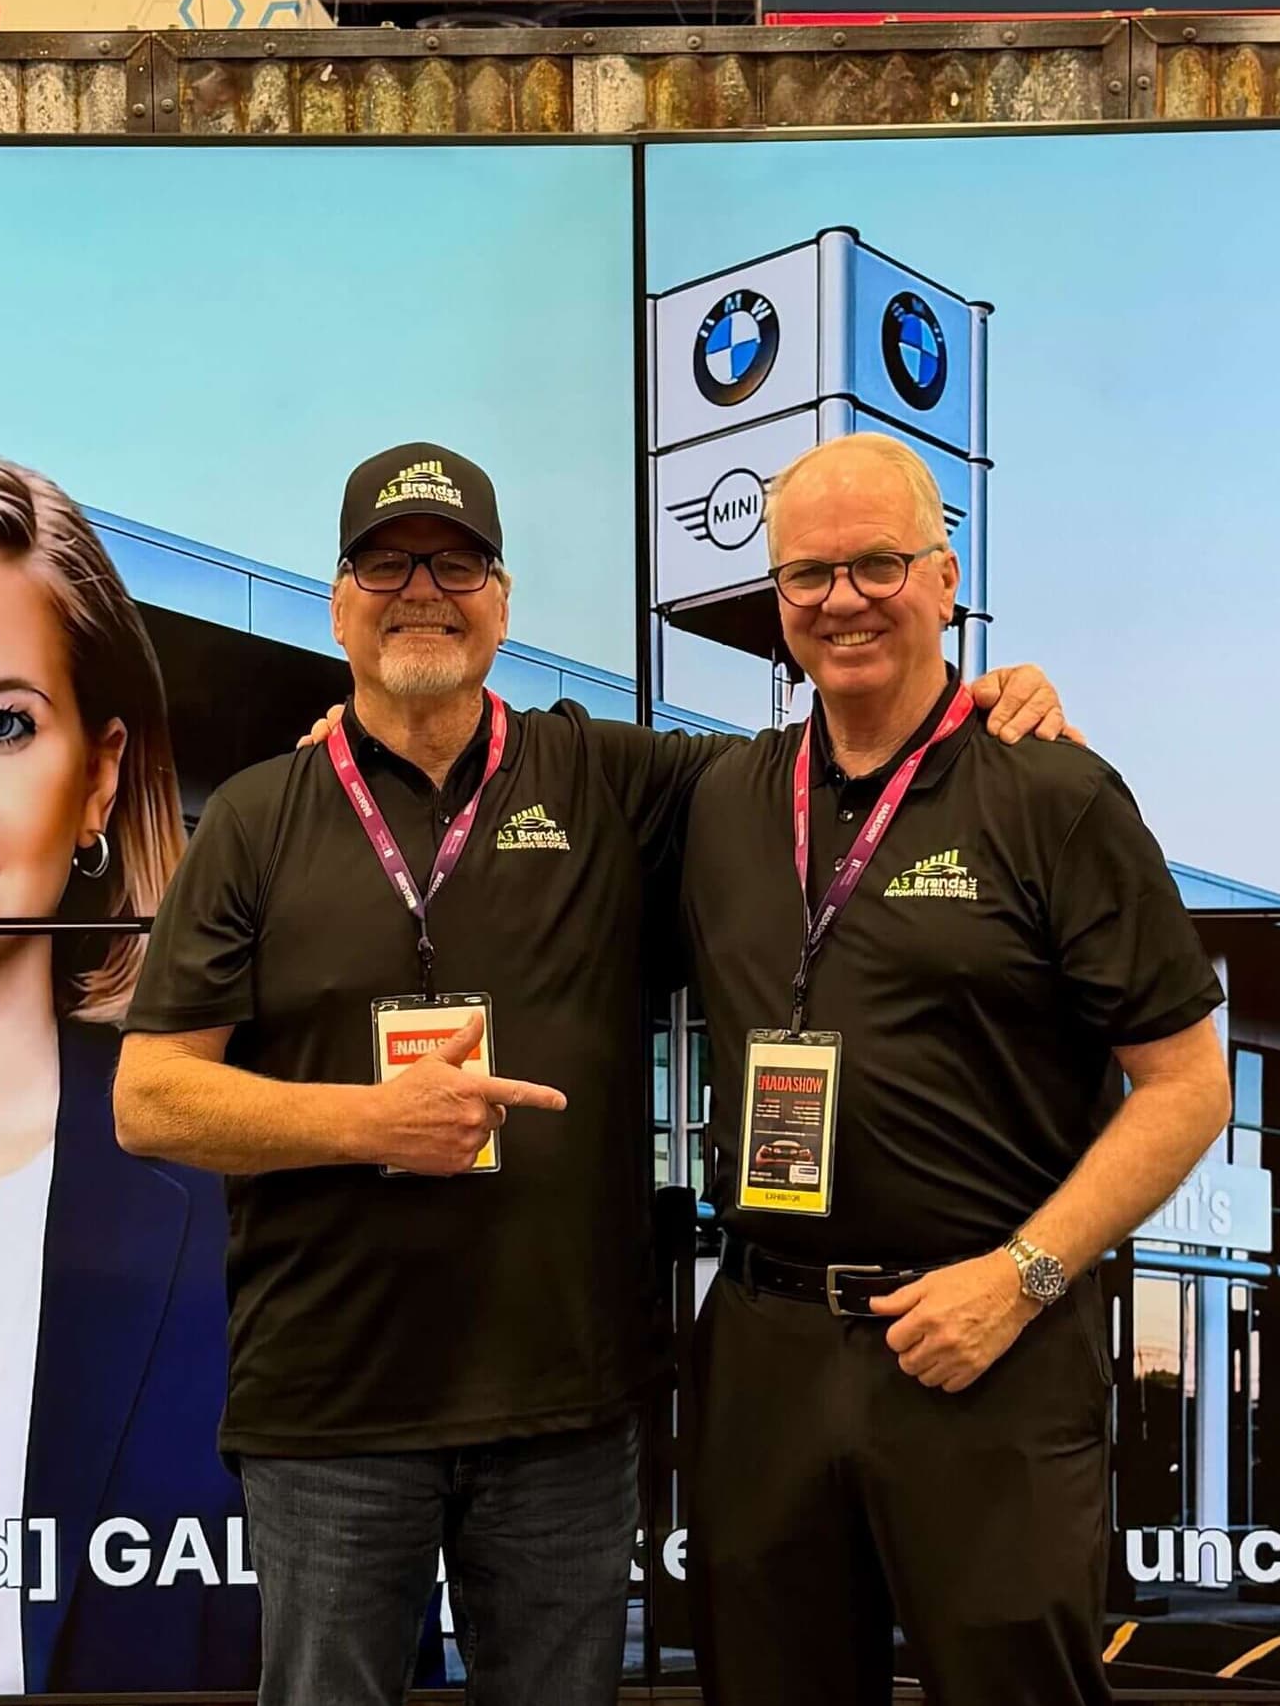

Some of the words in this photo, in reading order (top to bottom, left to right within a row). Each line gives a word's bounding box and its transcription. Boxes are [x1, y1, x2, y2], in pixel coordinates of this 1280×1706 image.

[712, 495, 759, 524] MINI
[497, 830, 513, 841] A3
[517, 828, 560, 842] Brands
[888, 877, 910, 889] A3
[913, 876, 968, 890] Brands
